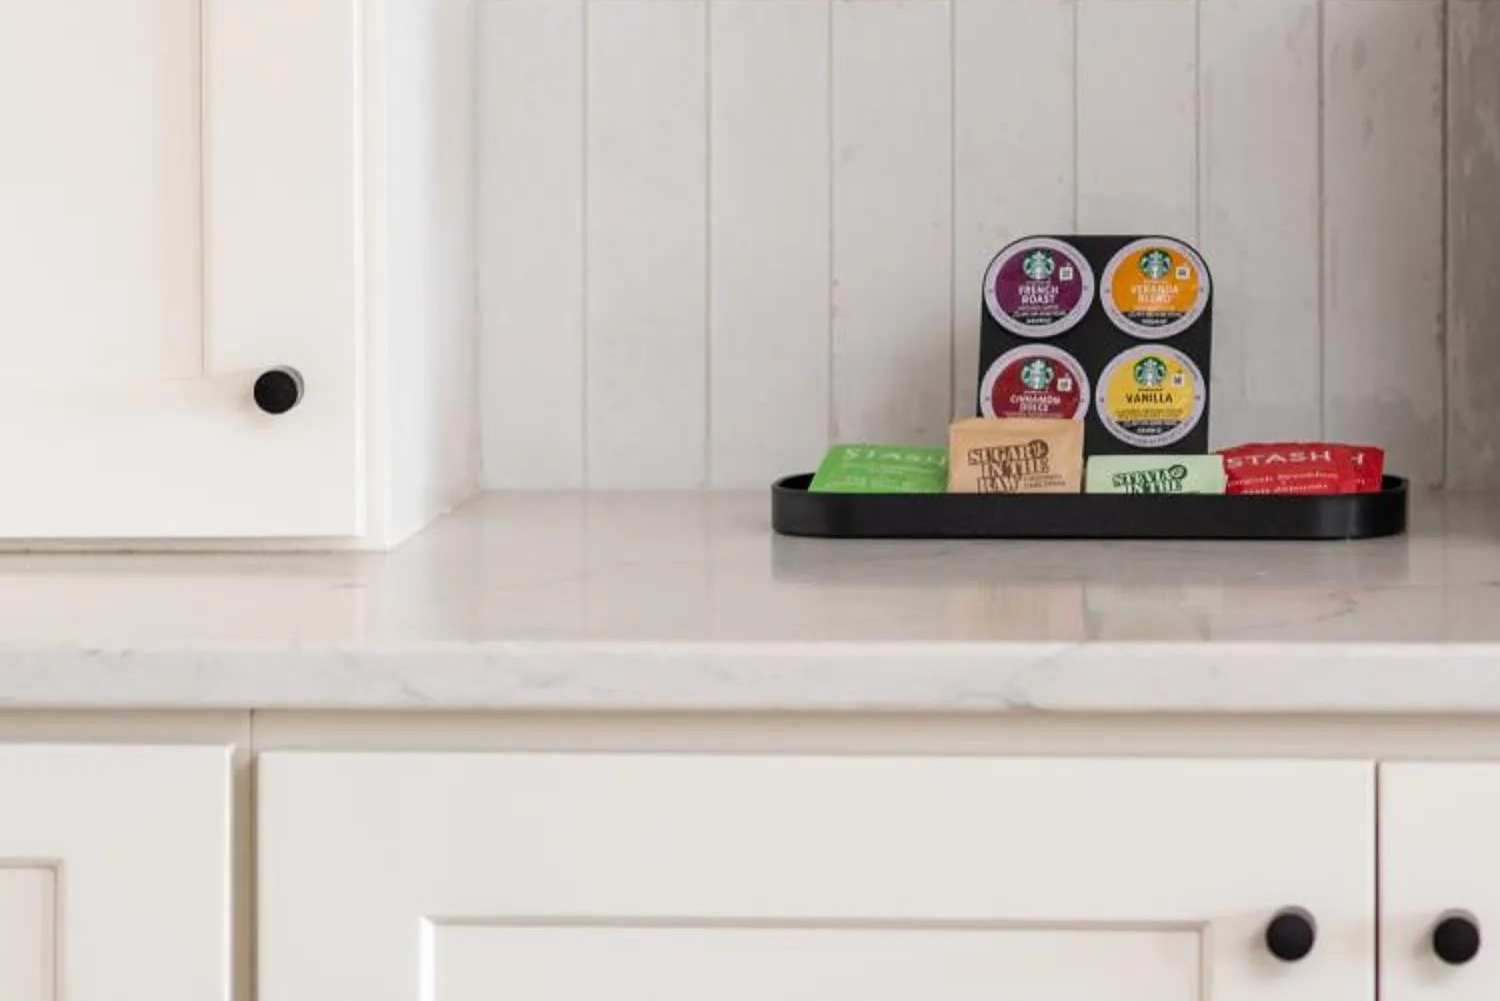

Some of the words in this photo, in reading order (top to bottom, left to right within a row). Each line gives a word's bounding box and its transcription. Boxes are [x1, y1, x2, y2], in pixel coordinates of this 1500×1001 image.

[1021, 294, 1056, 304] ROAST
[1125, 393, 1173, 404] VANILLA
[967, 445, 1032, 466] SUGAR
[1227, 450, 1332, 469] STASH
